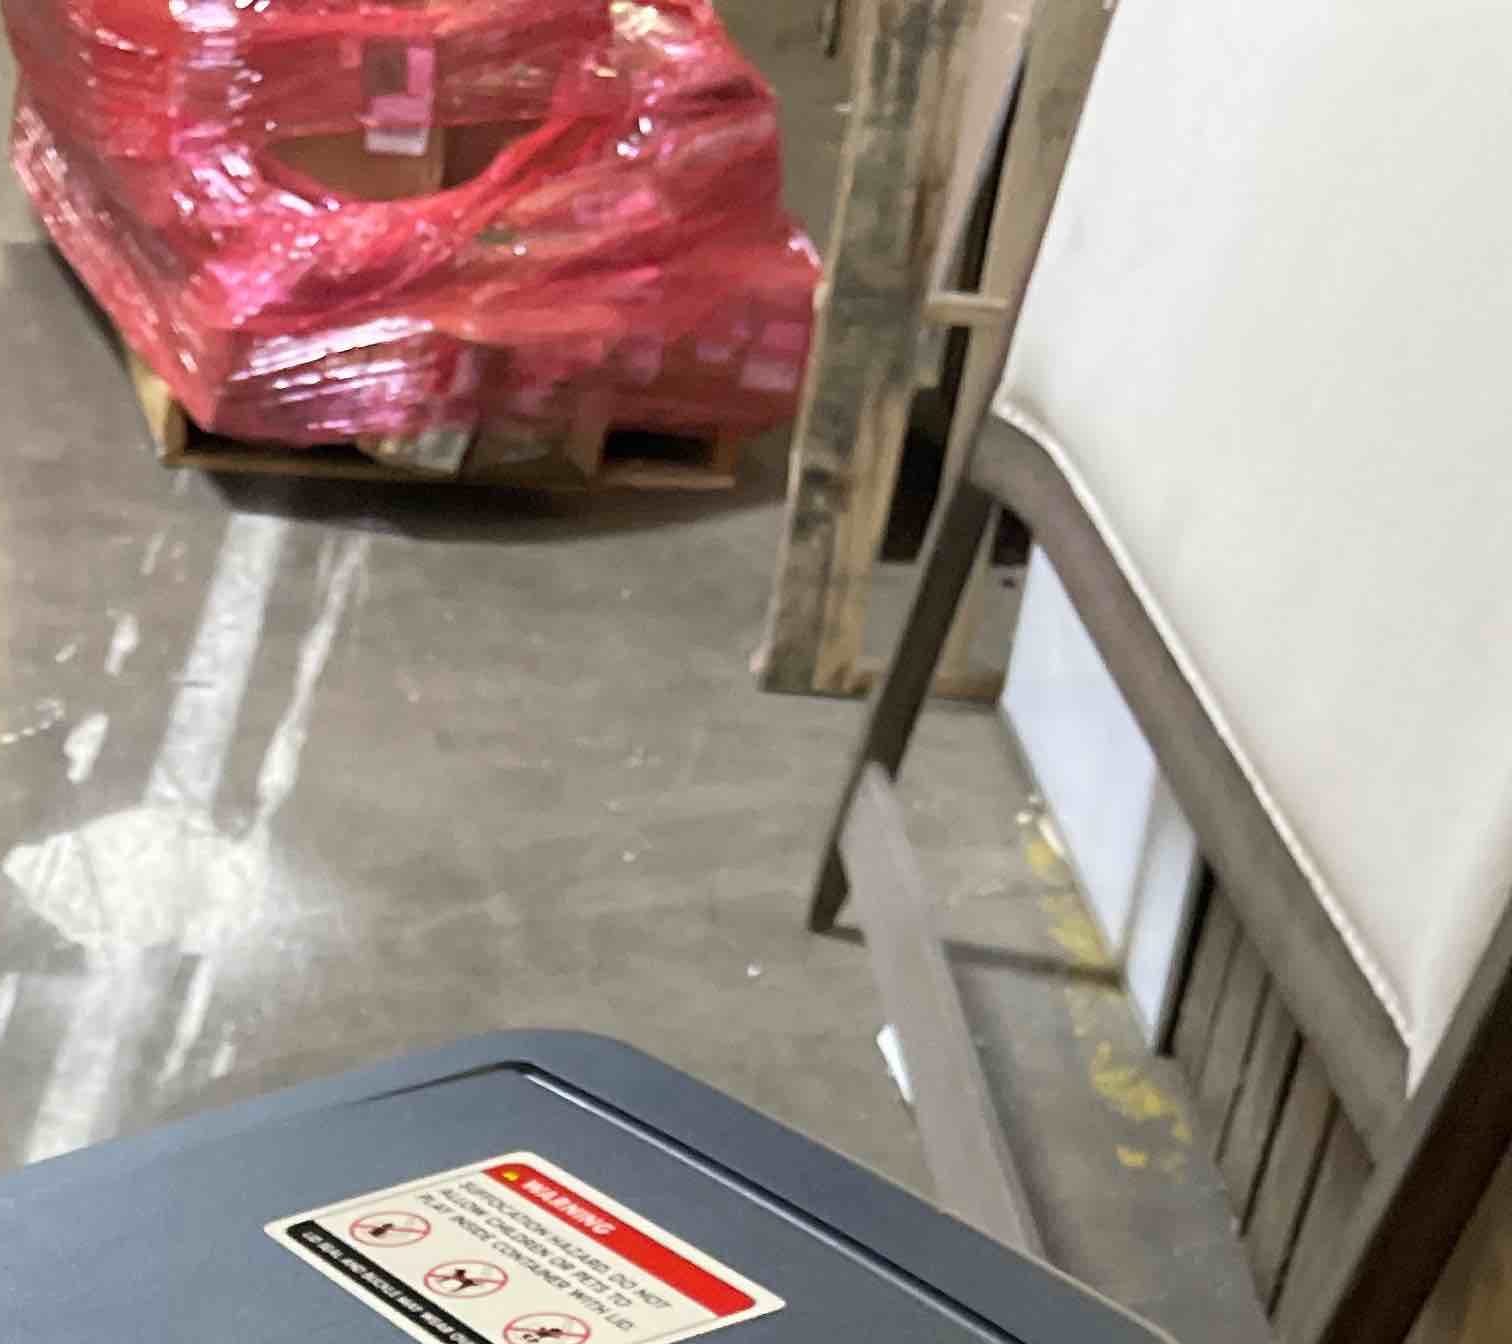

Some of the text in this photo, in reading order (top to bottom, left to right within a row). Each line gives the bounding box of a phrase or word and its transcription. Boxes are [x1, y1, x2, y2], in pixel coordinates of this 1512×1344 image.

[438, 1188, 633, 1306] ALLOW CHILDREN OR PETS TO
[521, 1180, 617, 1235] WARNING
[419, 1194, 453, 1214] PLAY
[452, 1216, 493, 1240] INSIDE
[491, 1241, 571, 1289] CONTAINER
[571, 1290, 607, 1313] WITH
[609, 1273, 639, 1289] DO
[638, 1289, 672, 1308] NOT
